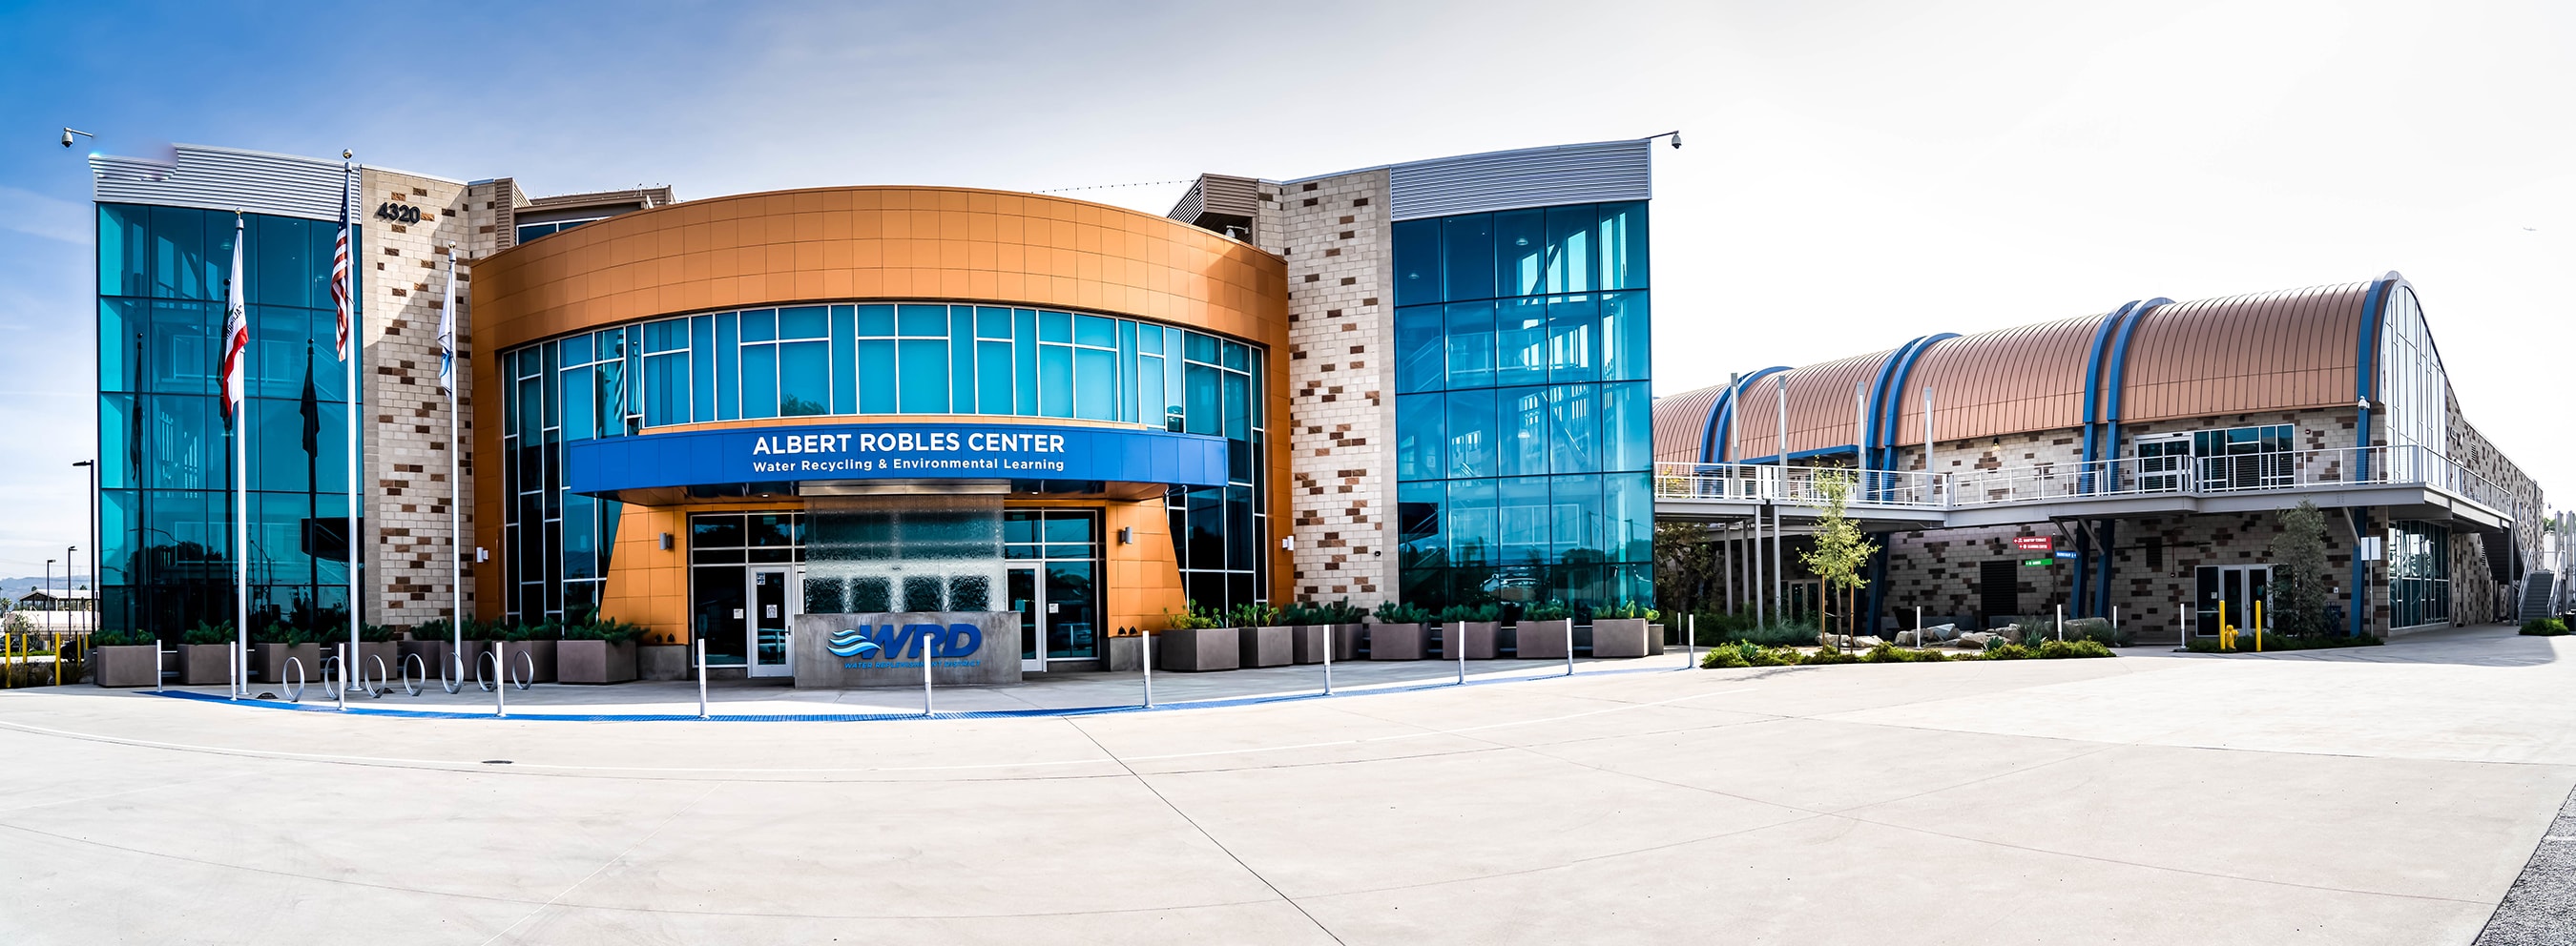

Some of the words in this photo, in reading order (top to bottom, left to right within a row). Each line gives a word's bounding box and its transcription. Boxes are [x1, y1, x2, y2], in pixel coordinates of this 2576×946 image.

[377, 201, 421, 224] 4320
[753, 434, 852, 455] ALBERT
[861, 432, 960, 452] ROBLES
[967, 433, 1065, 453] CENTER
[753, 462, 796, 472] Water
[801, 459, 872, 472] Recycling
[878, 459, 887, 469] &
[893, 458, 998, 469] Environmental
[1004, 459, 1064, 472] Learning
[860, 624, 982, 658] WRD
